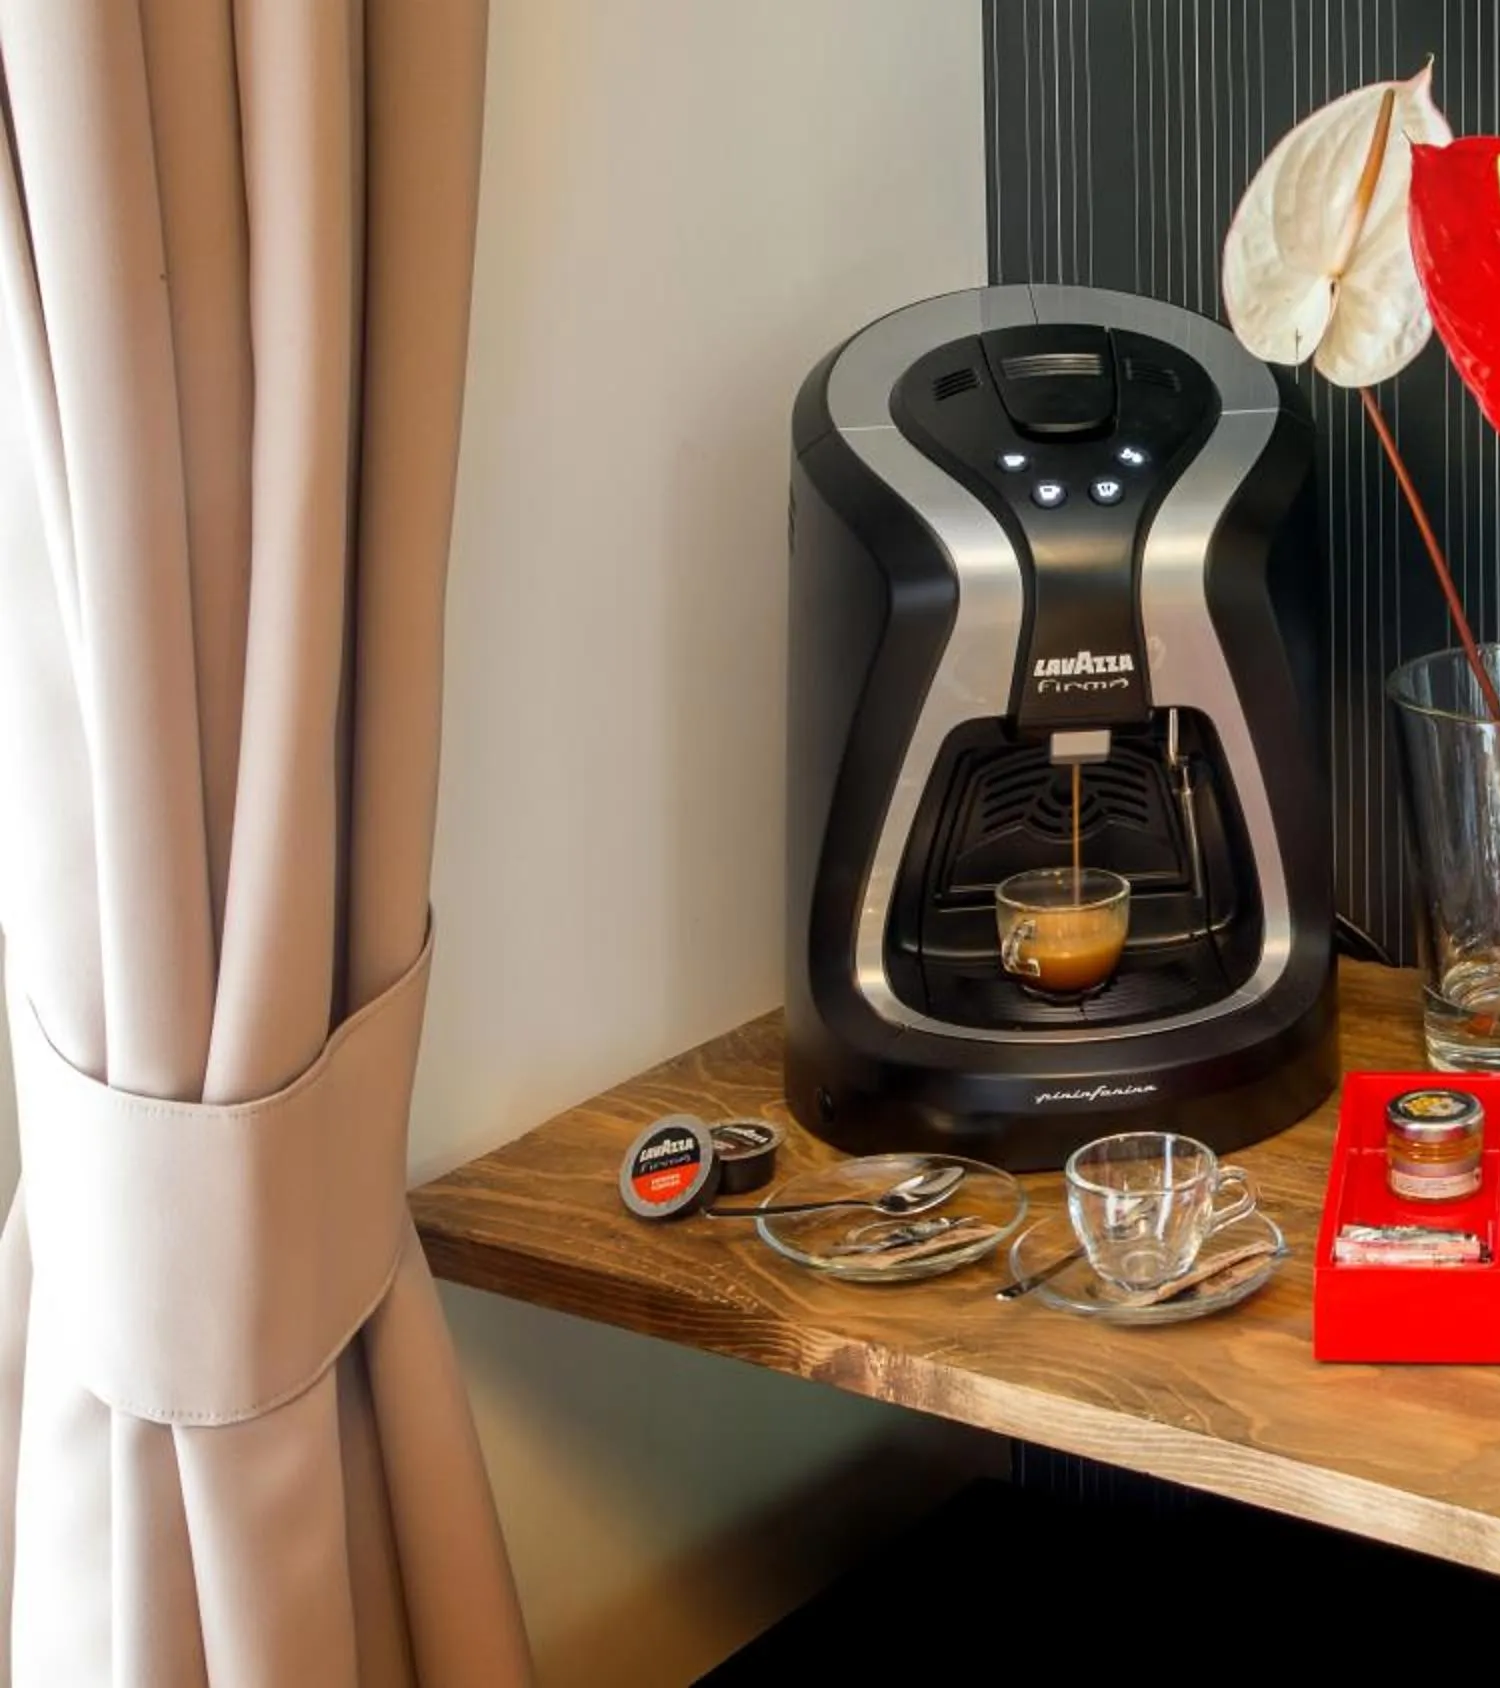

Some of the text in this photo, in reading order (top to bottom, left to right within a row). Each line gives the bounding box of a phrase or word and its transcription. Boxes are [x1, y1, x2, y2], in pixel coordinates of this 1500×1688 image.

[1033, 651, 1135, 678] LAVAZZA
[1035, 1084, 1158, 1105] pininfarina
[639, 1136, 695, 1163] LAVAZZA
